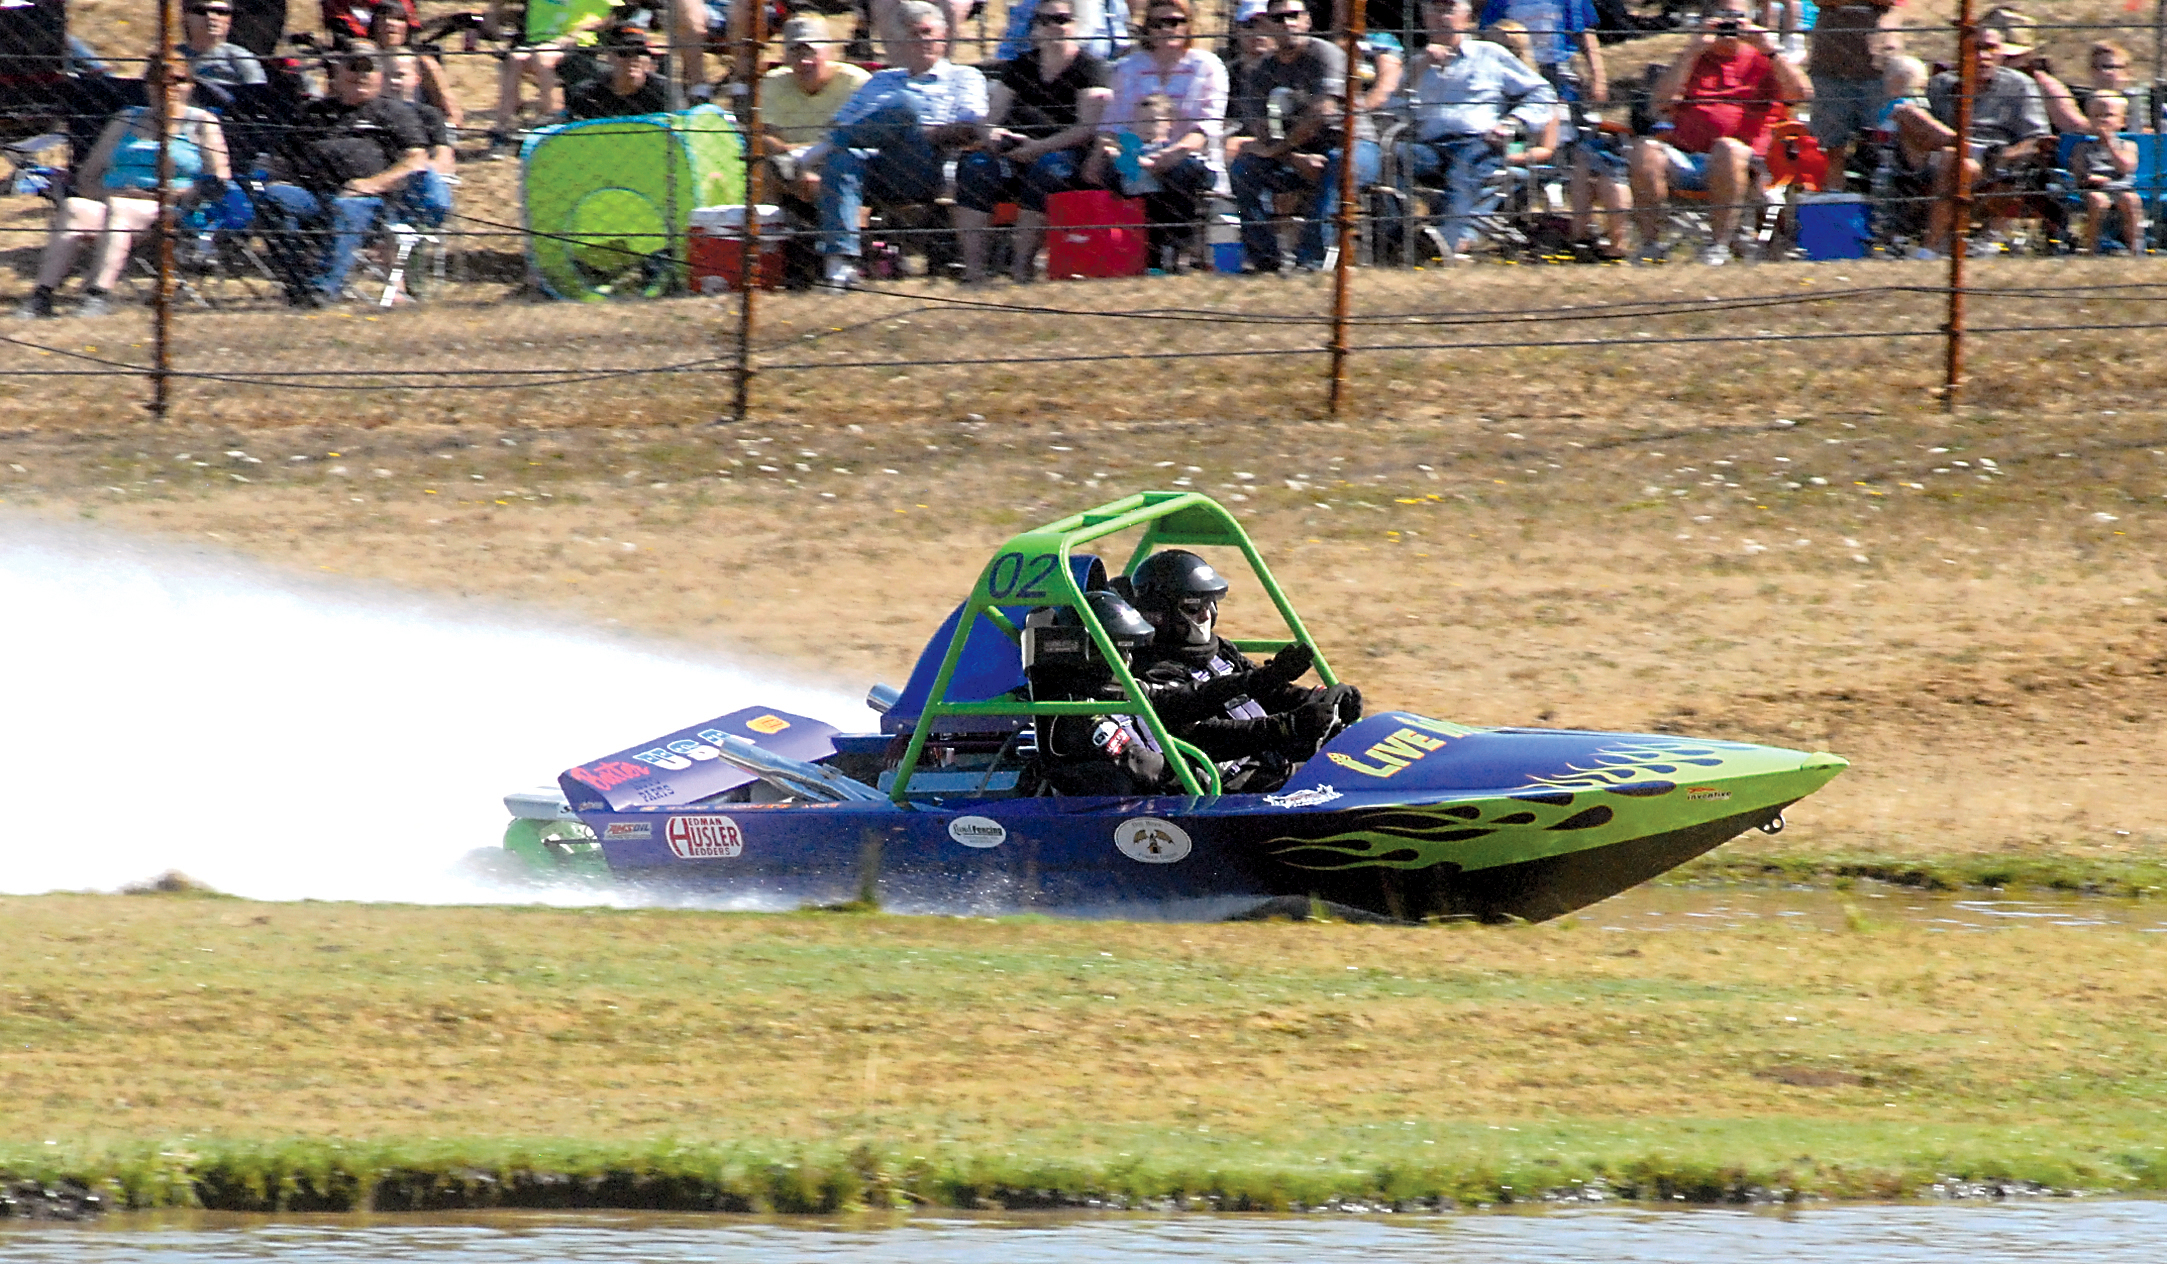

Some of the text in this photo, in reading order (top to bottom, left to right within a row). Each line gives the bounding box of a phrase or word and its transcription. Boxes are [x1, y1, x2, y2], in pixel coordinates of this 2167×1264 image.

[989, 552, 1059, 599] 02
[1327, 728, 1447, 778] LIVE
[638, 785, 675, 802] PARTS
